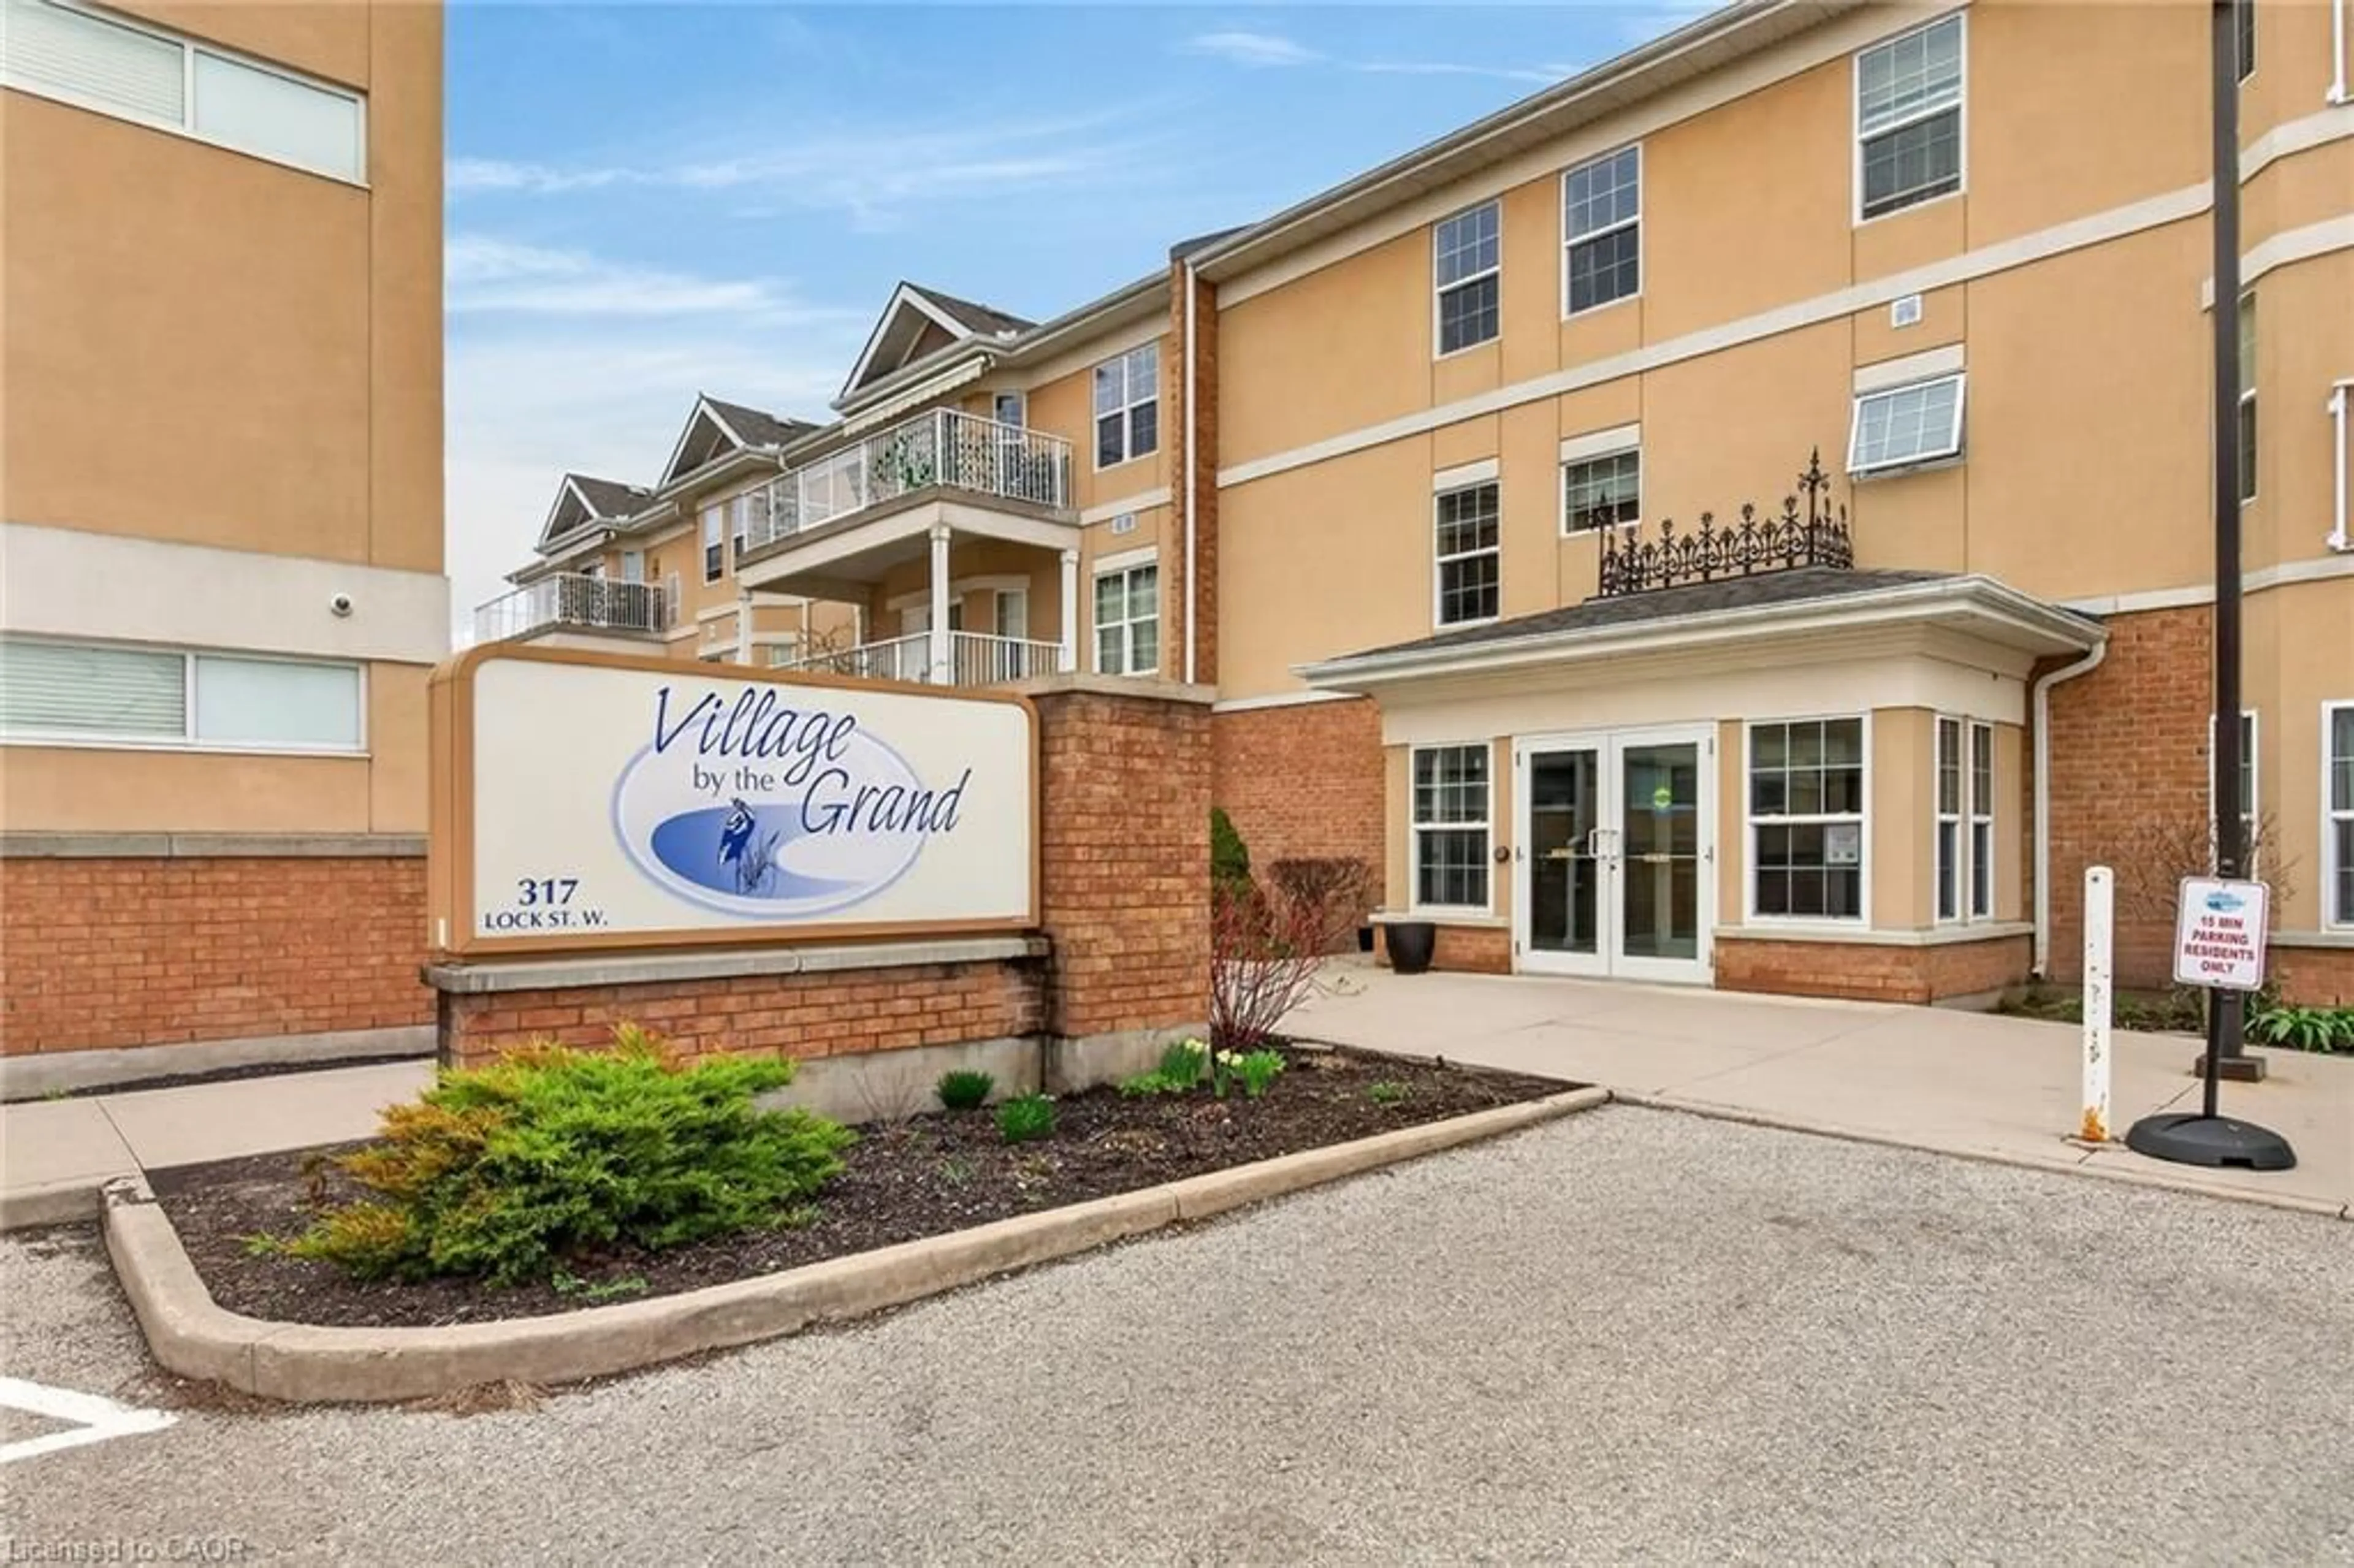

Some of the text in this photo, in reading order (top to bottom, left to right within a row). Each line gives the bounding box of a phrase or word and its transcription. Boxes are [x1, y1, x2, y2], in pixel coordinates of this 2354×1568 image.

[655, 686, 856, 786] Village
[693, 764, 775, 796] by the
[801, 768, 972, 834] Grand
[518, 878, 578, 906] 317
[484, 910, 608, 929] LOCK ST. W.
[2201, 916, 2244, 929] 15 MIN
[2192, 930, 2249, 945] PARKING
[2184, 944, 2255, 961] RESIDENTS
[2200, 960, 2235, 973] ONLY
